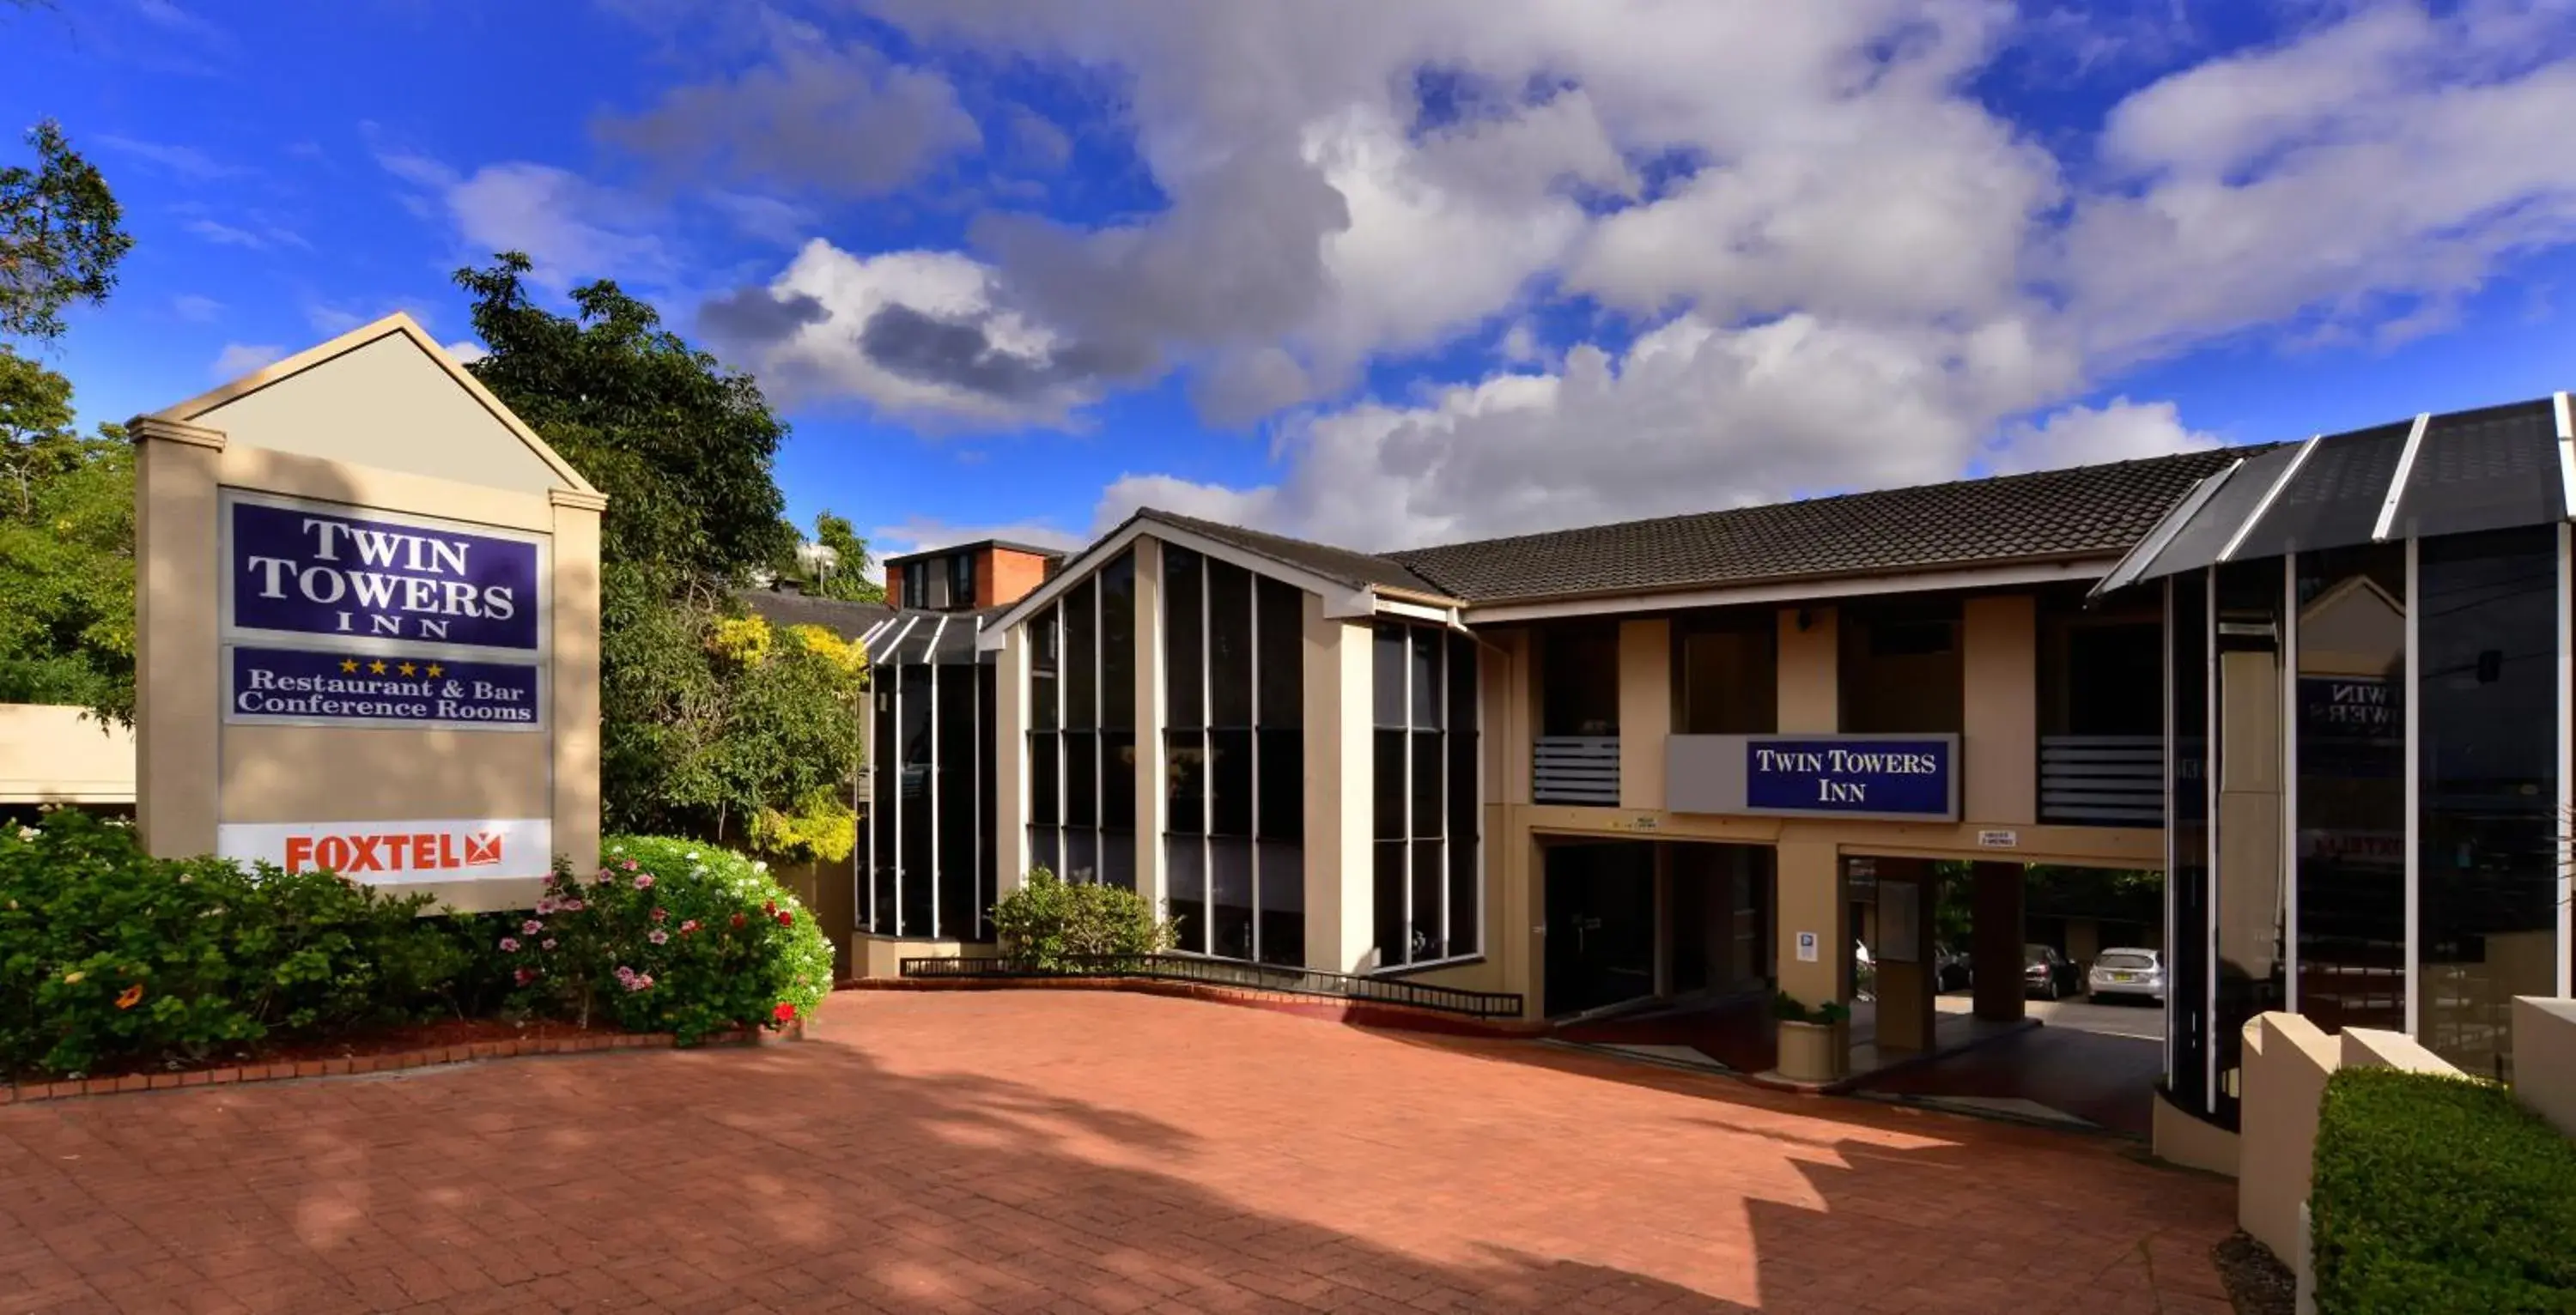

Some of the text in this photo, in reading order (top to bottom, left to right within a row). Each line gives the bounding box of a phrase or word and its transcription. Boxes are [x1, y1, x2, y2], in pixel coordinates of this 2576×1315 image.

[302, 518, 471, 577] TWIN
[248, 555, 515, 621] TOWERS
[337, 611, 451, 639] INN
[246, 669, 525, 702] Restaurant & Bar
[238, 691, 532, 721] Conference Rooms
[1756, 749, 1937, 774] TWIN TOWERS
[1818, 779, 1867, 803] INN
[285, 833, 462, 875] FOXTEL
